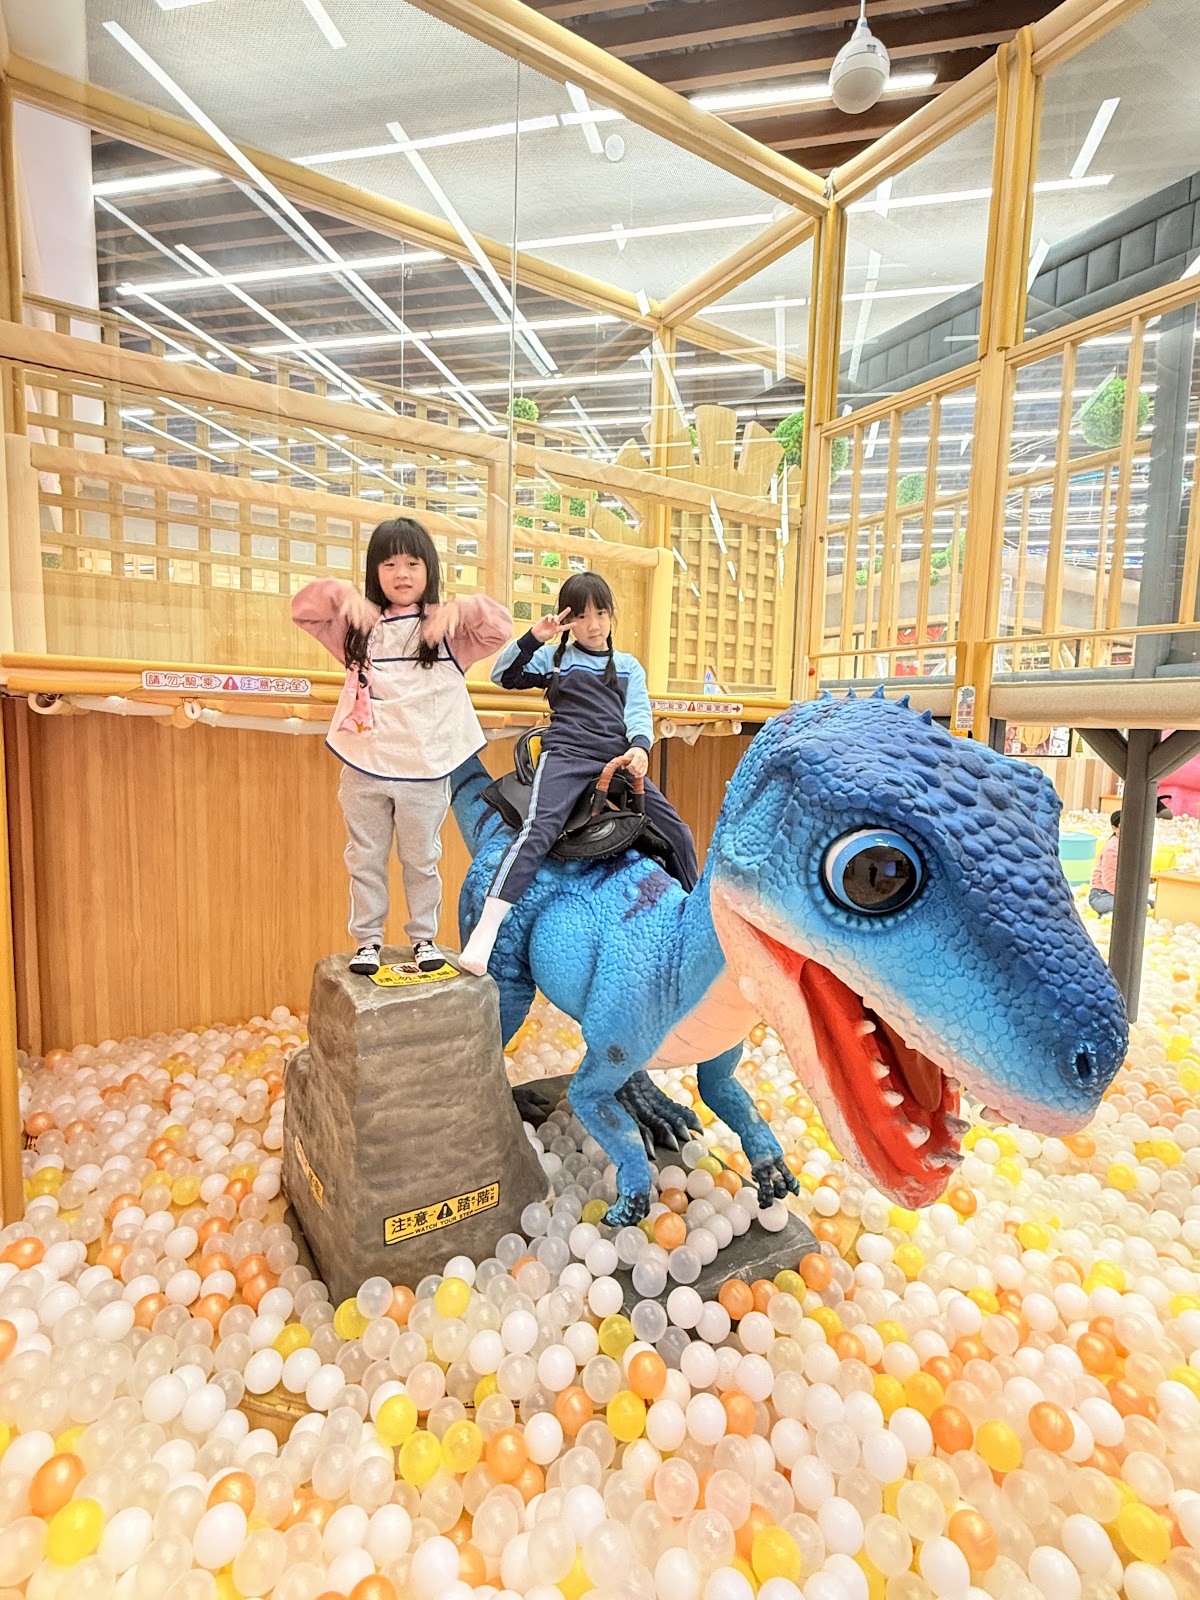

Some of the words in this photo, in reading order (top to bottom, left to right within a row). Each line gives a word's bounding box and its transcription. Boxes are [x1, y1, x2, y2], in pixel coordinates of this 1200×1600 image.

[242, 678, 303, 691] 注意安全
[391, 1211, 429, 1234] 注意
[415, 1222, 438, 1234] WATCH
[440, 1216, 457, 1226] YOUR
[459, 1209, 474, 1219] STEP
